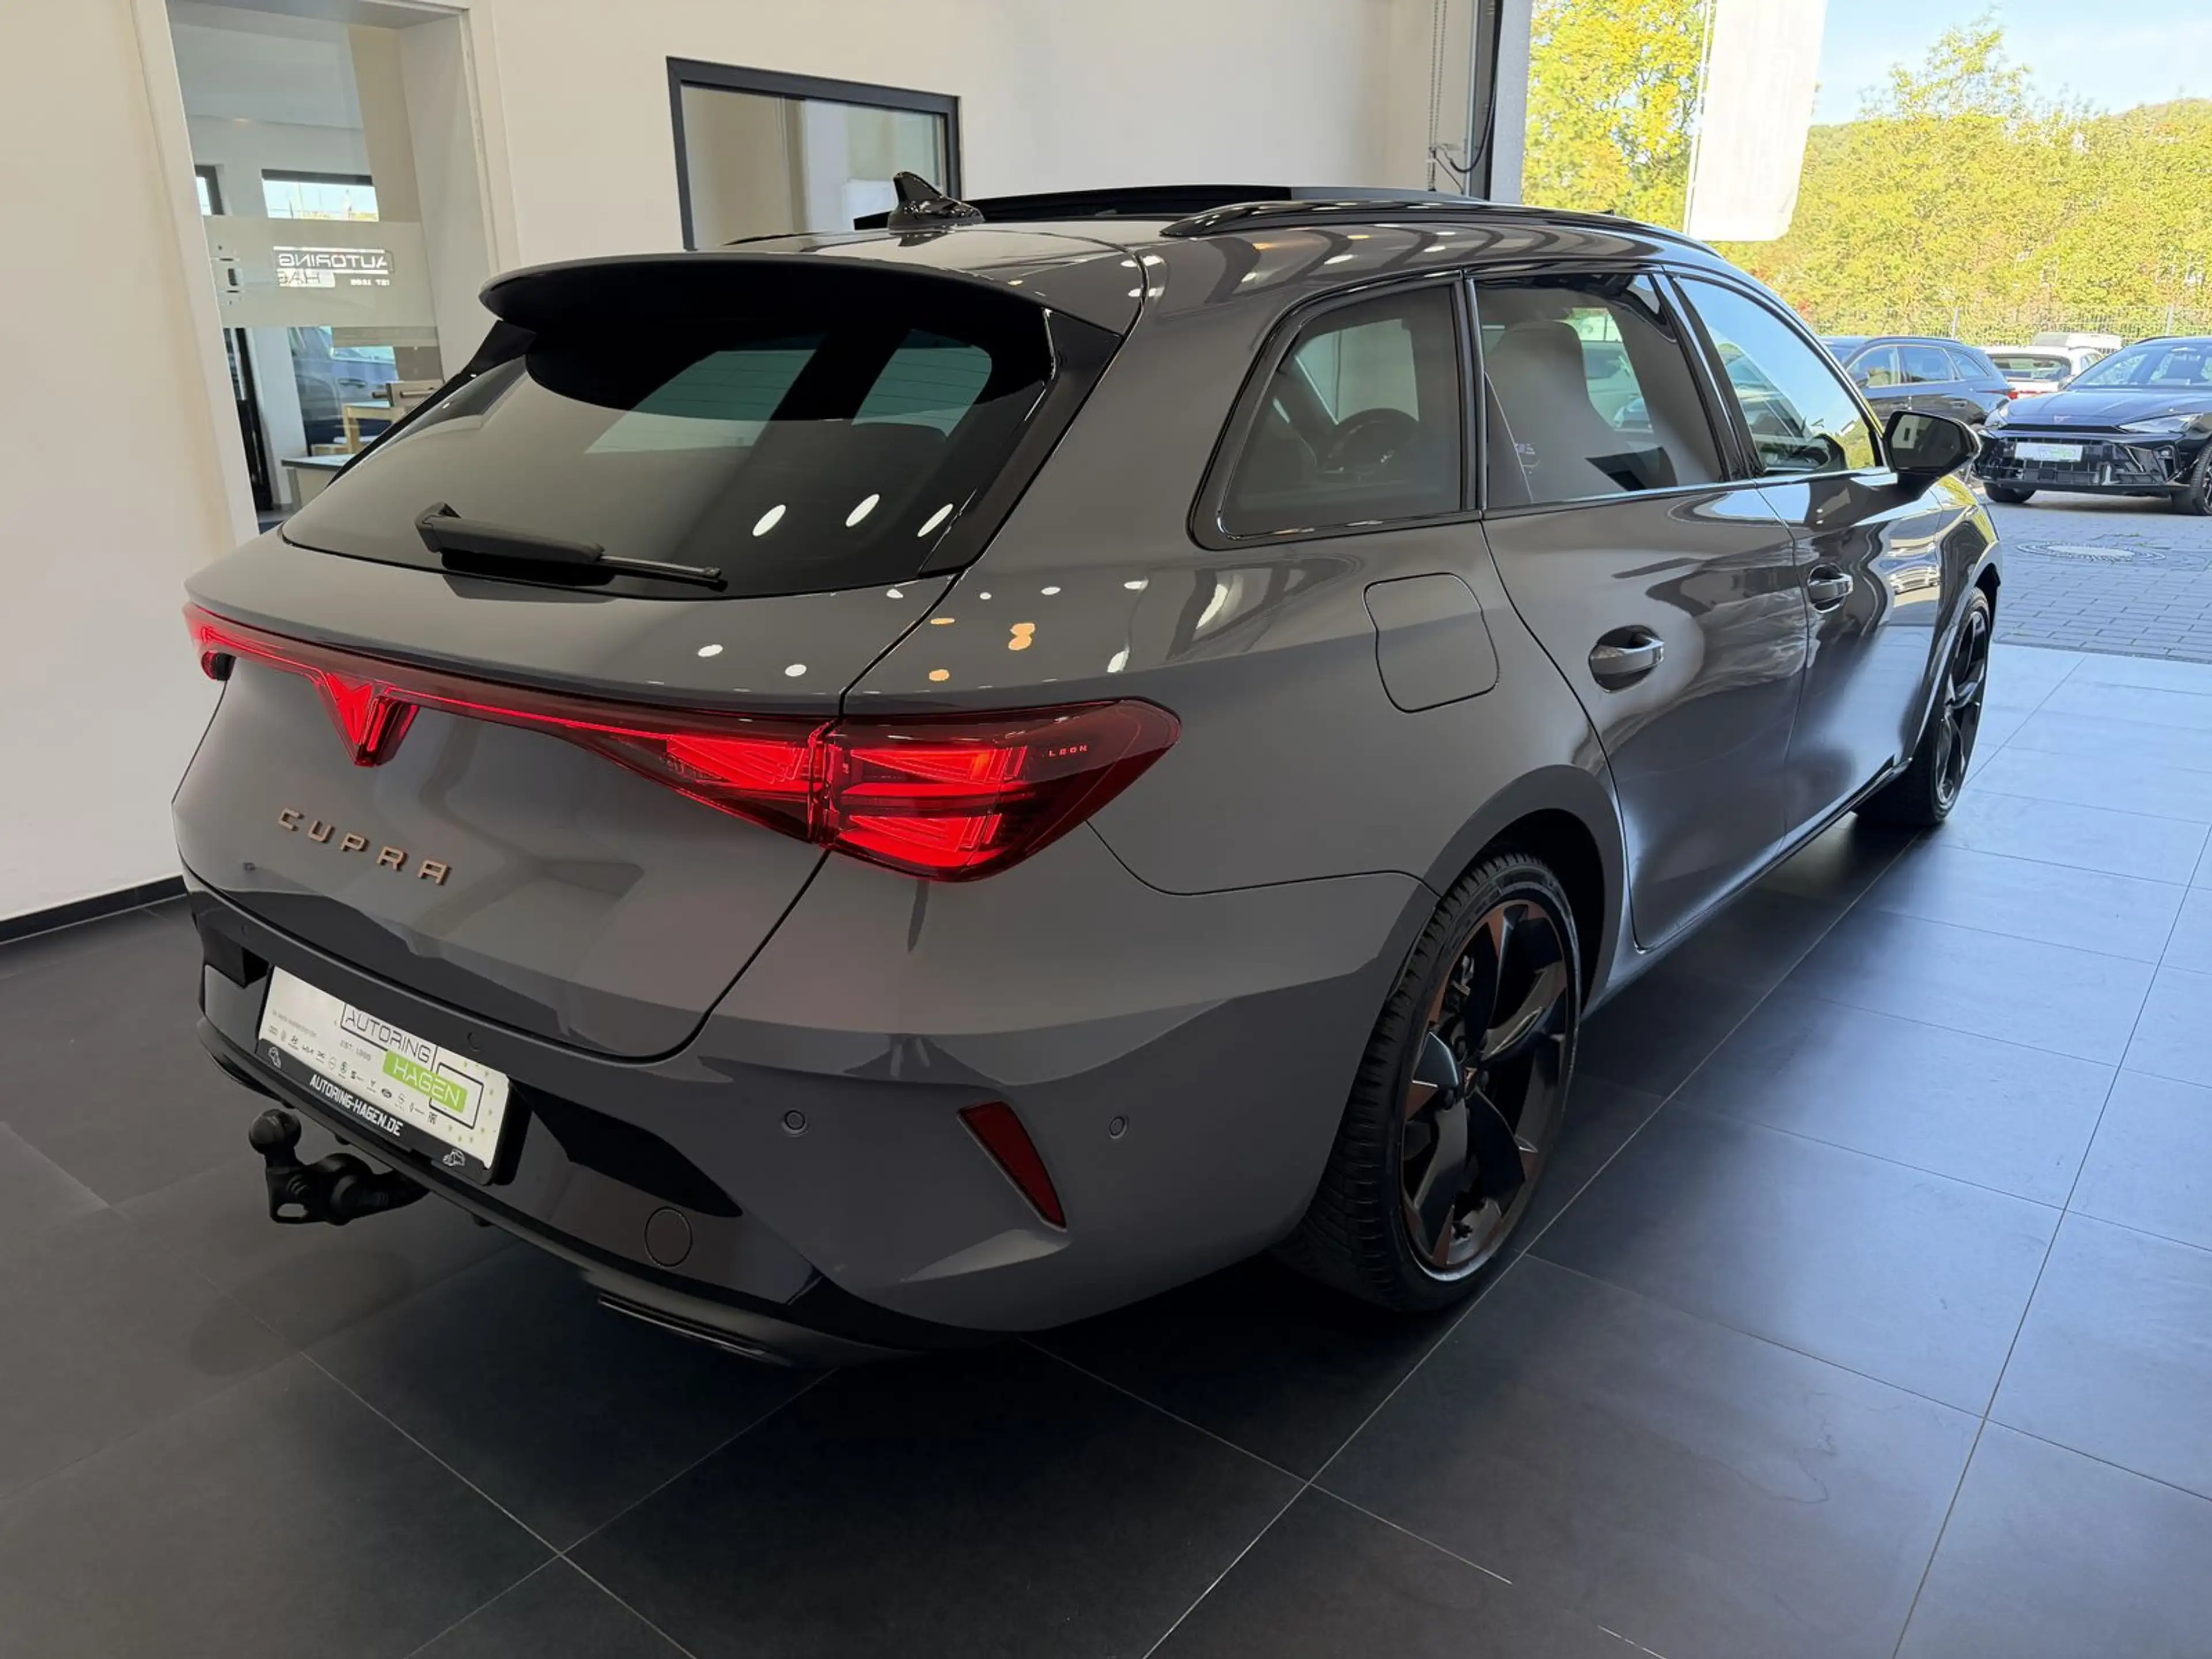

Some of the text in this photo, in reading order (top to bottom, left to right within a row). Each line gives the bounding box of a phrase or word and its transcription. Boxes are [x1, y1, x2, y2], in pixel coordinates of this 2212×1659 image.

[1049, 745, 1088, 757] LEON
[278, 807, 449, 885] CUPRA
[345, 1008, 431, 1063] AUTORING
[309, 1074, 404, 1137] AUTORING-HAGEN.DE
[393, 1058, 461, 1107] HAGEN
